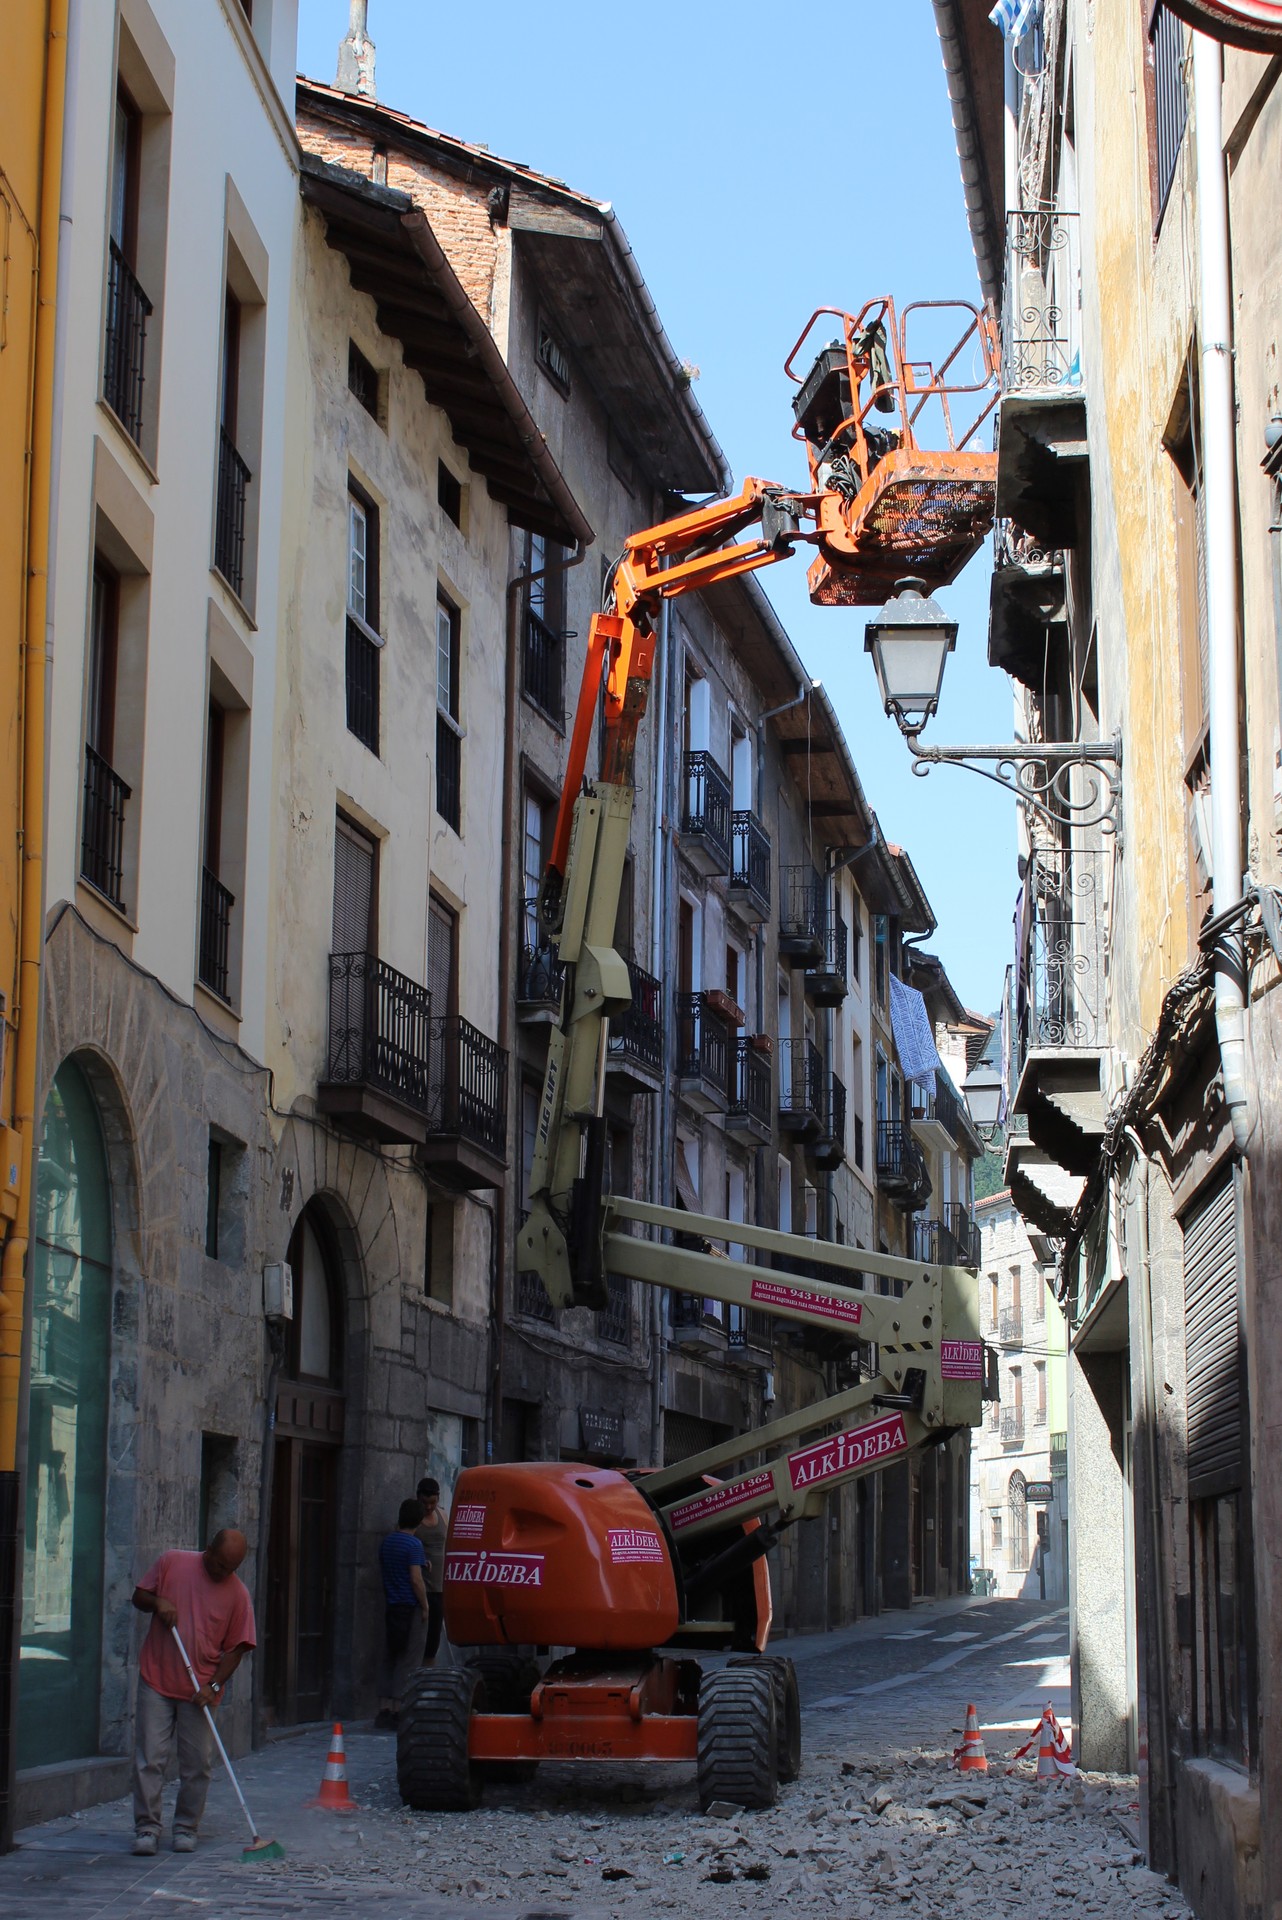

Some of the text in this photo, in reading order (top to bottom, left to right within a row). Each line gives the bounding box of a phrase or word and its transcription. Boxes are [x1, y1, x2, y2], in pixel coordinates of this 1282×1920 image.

[540, 1060, 558, 1145] JLG LIFT
[755, 1281, 859, 1311] MALLABIA 943 171 362
[672, 1472, 770, 1518] MALLABIA 943 171 362
